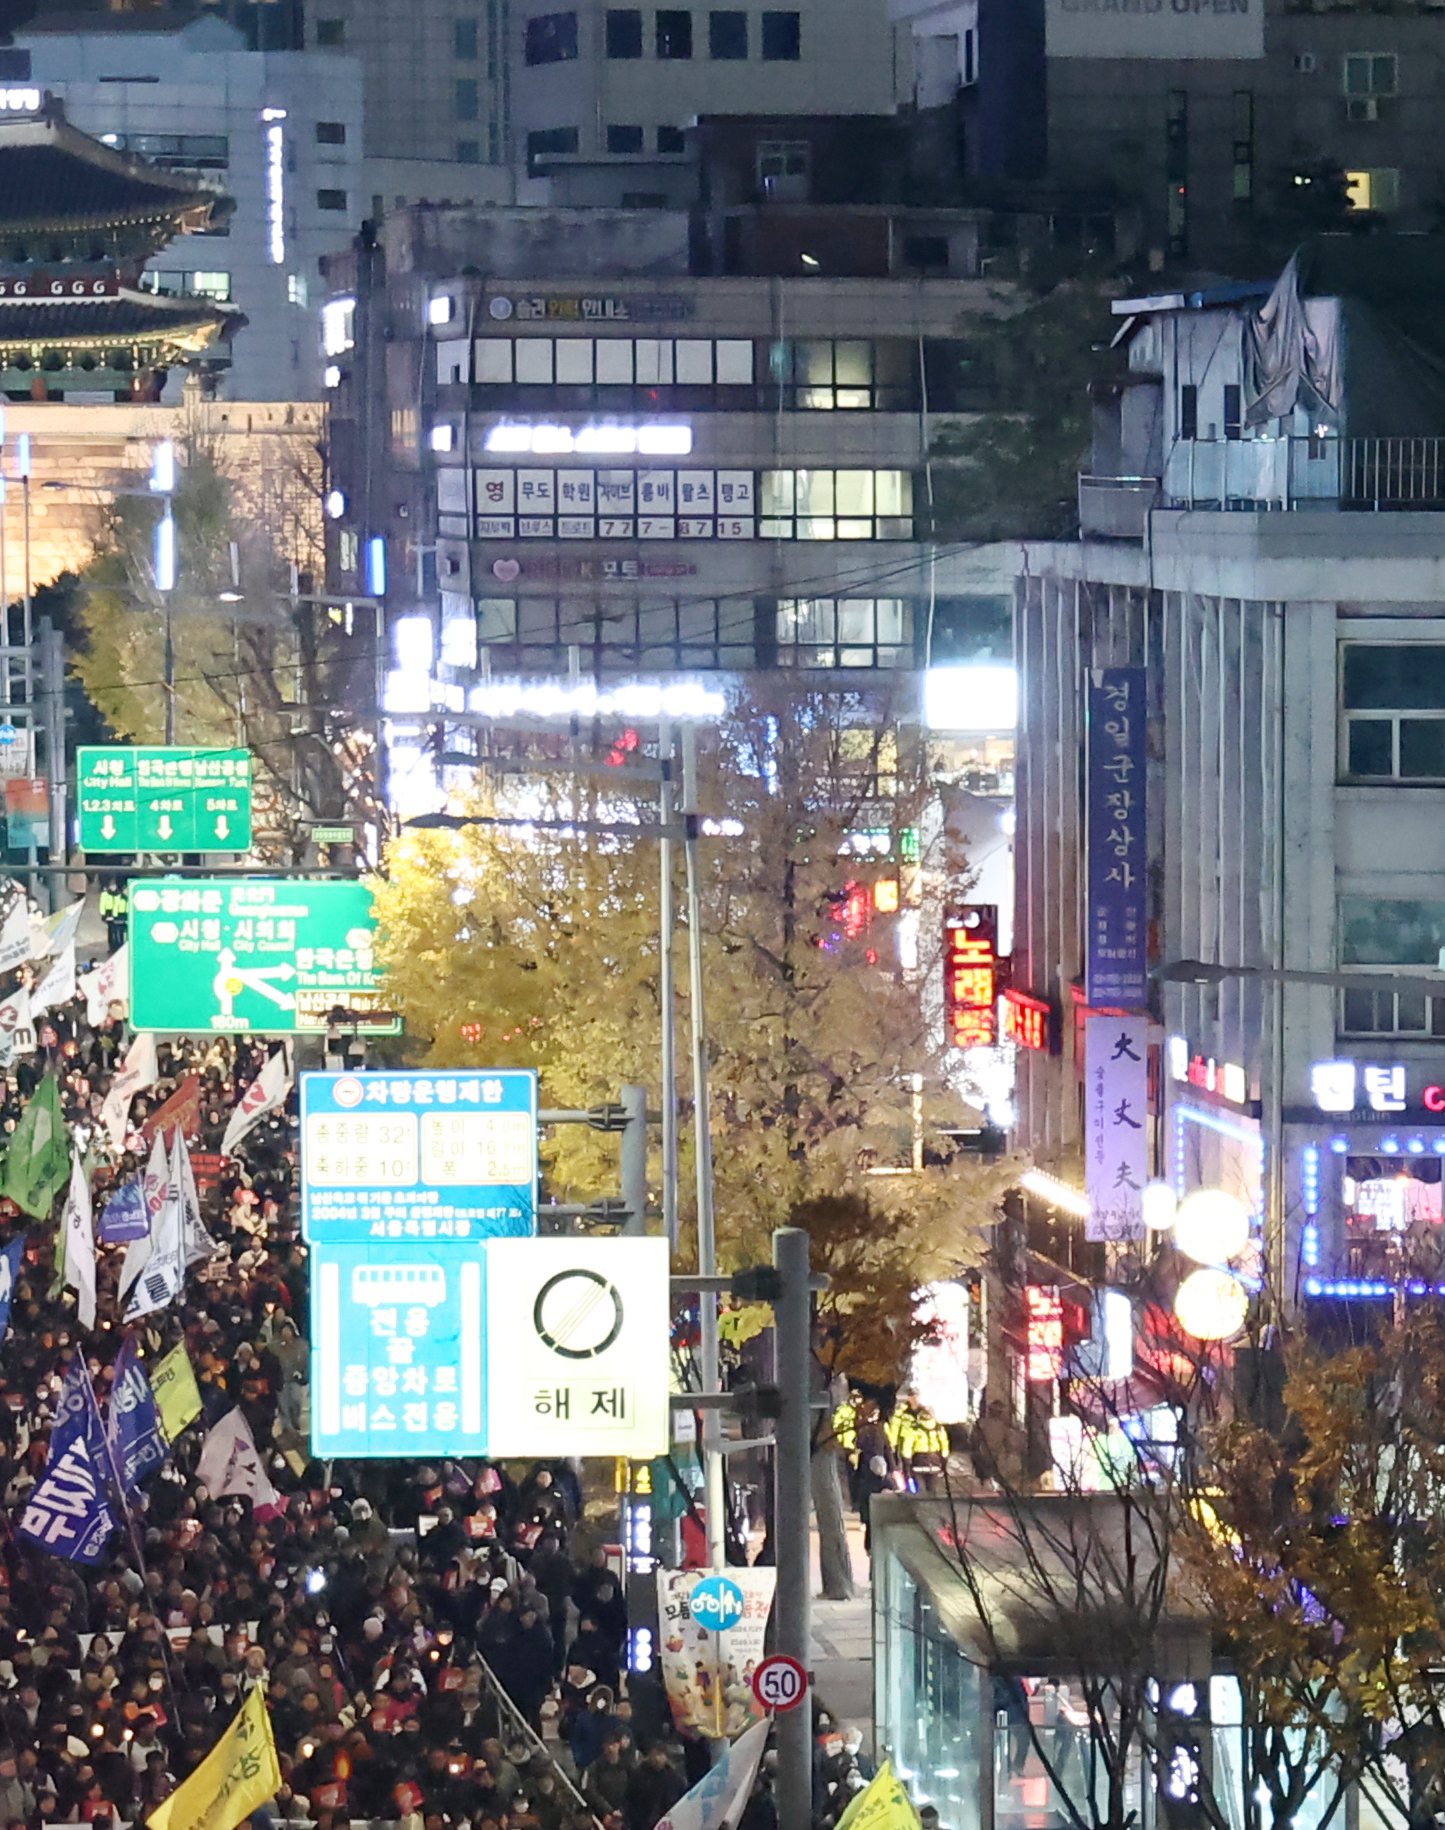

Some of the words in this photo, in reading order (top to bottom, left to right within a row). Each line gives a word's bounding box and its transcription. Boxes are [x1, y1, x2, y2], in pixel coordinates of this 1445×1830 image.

[522, 482, 551, 499] 무도
[562, 482, 591, 501] 학원
[161, 890, 223, 912] 광화문
[180, 920, 221, 939] 시청
[234, 920, 296, 939] 시의회
[179, 940, 199, 952] City
[233, 940, 254, 952] City
[297, 972, 316, 984] The
[319, 972, 344, 984] Bank
[347, 972, 360, 984] Of
[211, 1015, 249, 1028] 180m
[366, 1080, 503, 1104] 차량운행제한
[1110, 1032, 1142, 1190] 大丈夫
[316, 1123, 369, 1144] 총중량
[443, 1160, 457, 1177] 폭
[370, 1220, 471, 1237] 서울특별시장
[370, 1307, 430, 1337] 전용
[343, 1365, 458, 1396] 중앙차로
[343, 1402, 458, 1432] 버스전용
[764, 1671, 798, 1699] 50
